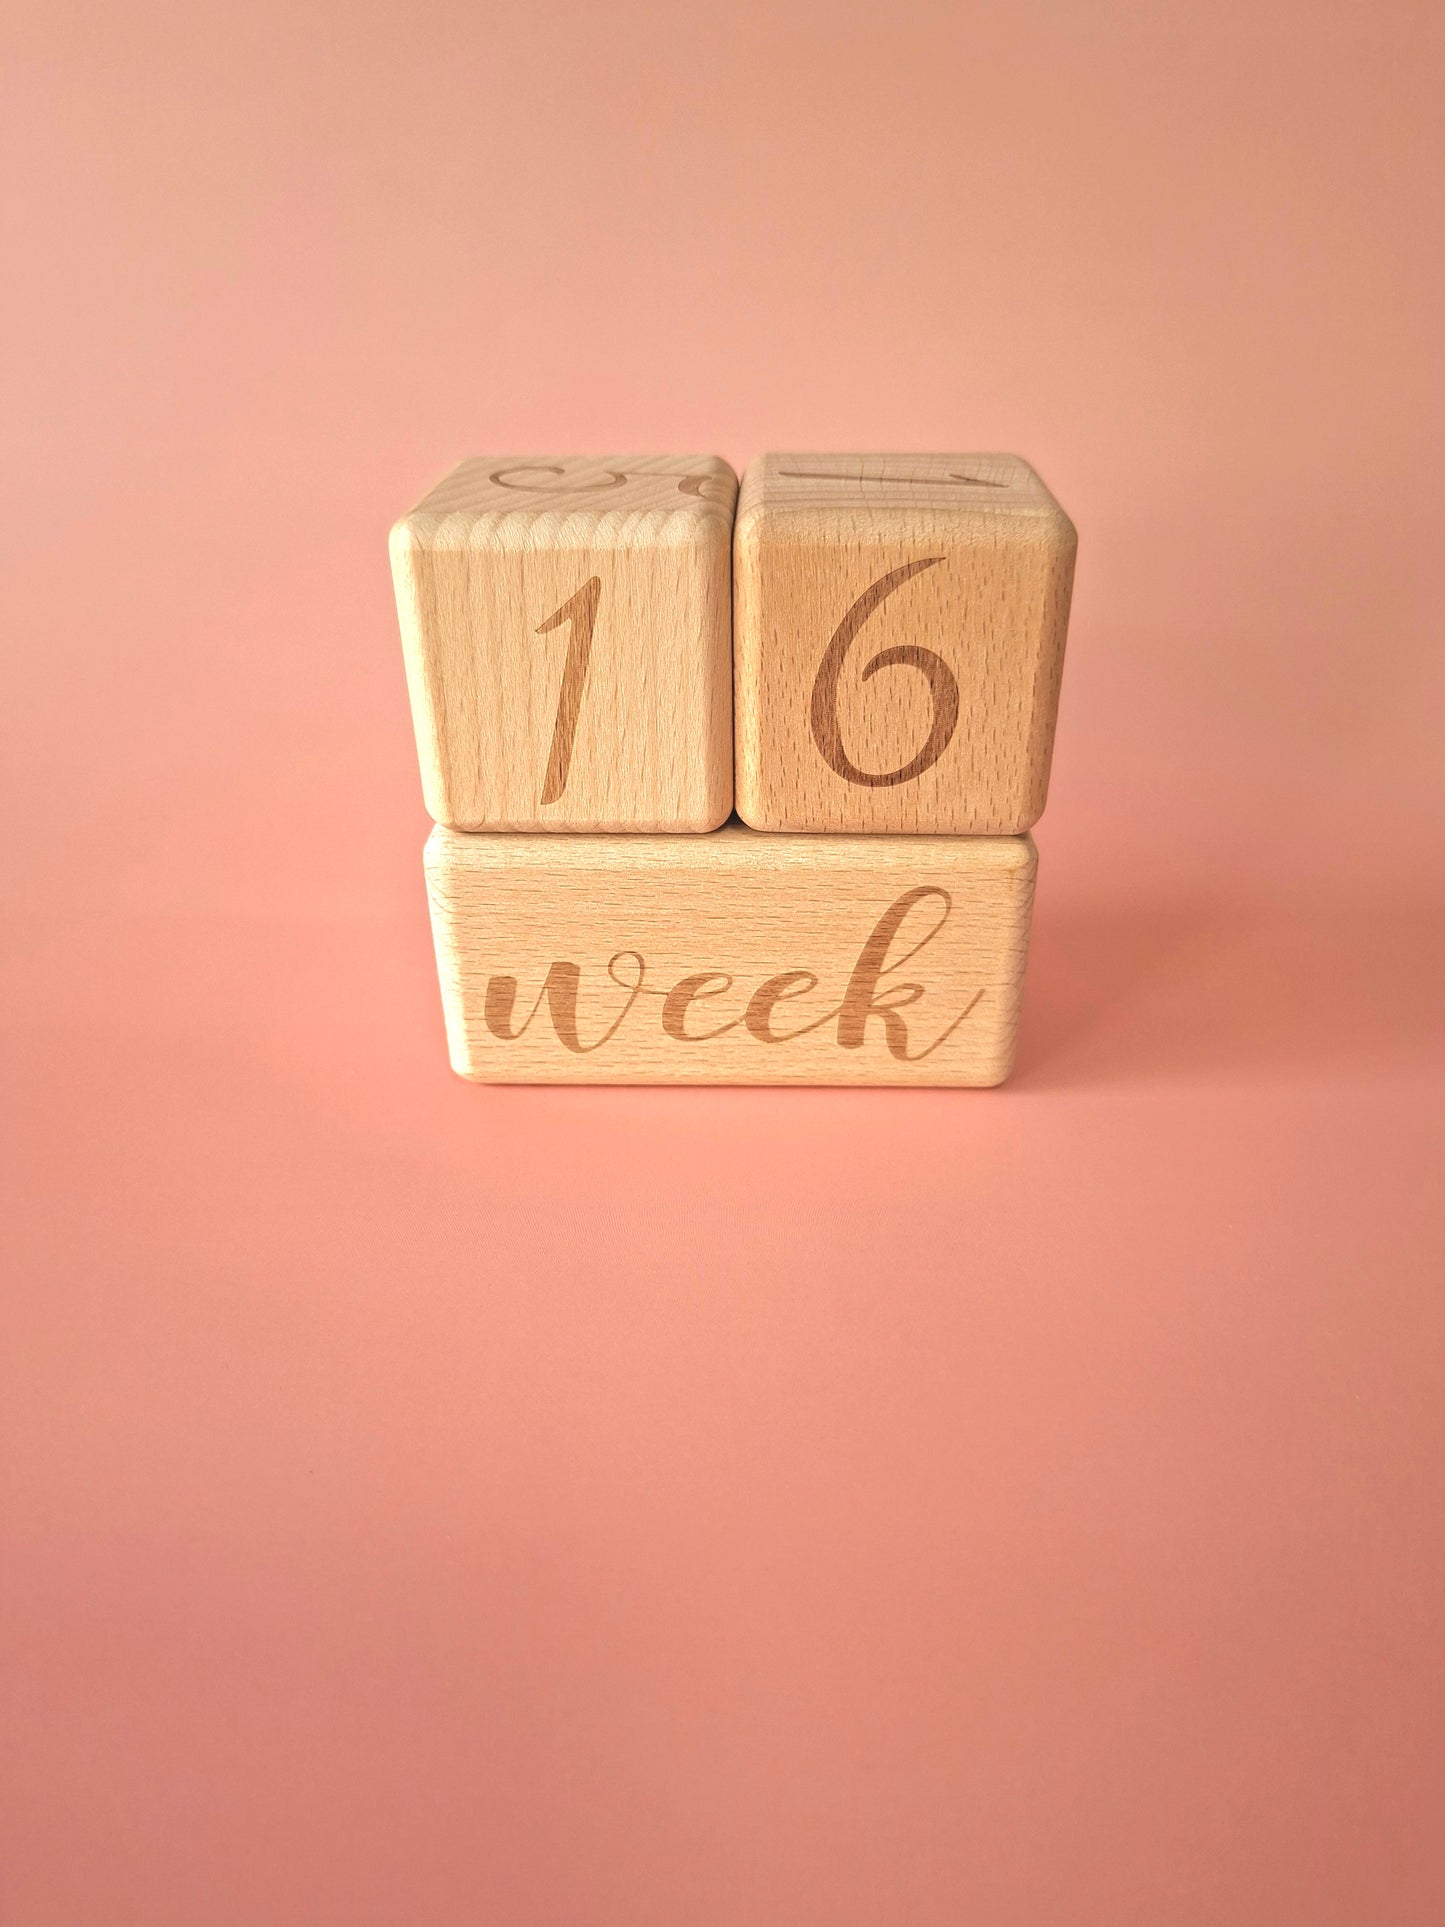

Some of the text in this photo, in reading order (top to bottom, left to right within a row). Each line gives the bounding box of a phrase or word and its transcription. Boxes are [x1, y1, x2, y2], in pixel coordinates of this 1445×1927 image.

[535, 556, 960, 805] 1 6
[484, 885, 985, 1060] week
